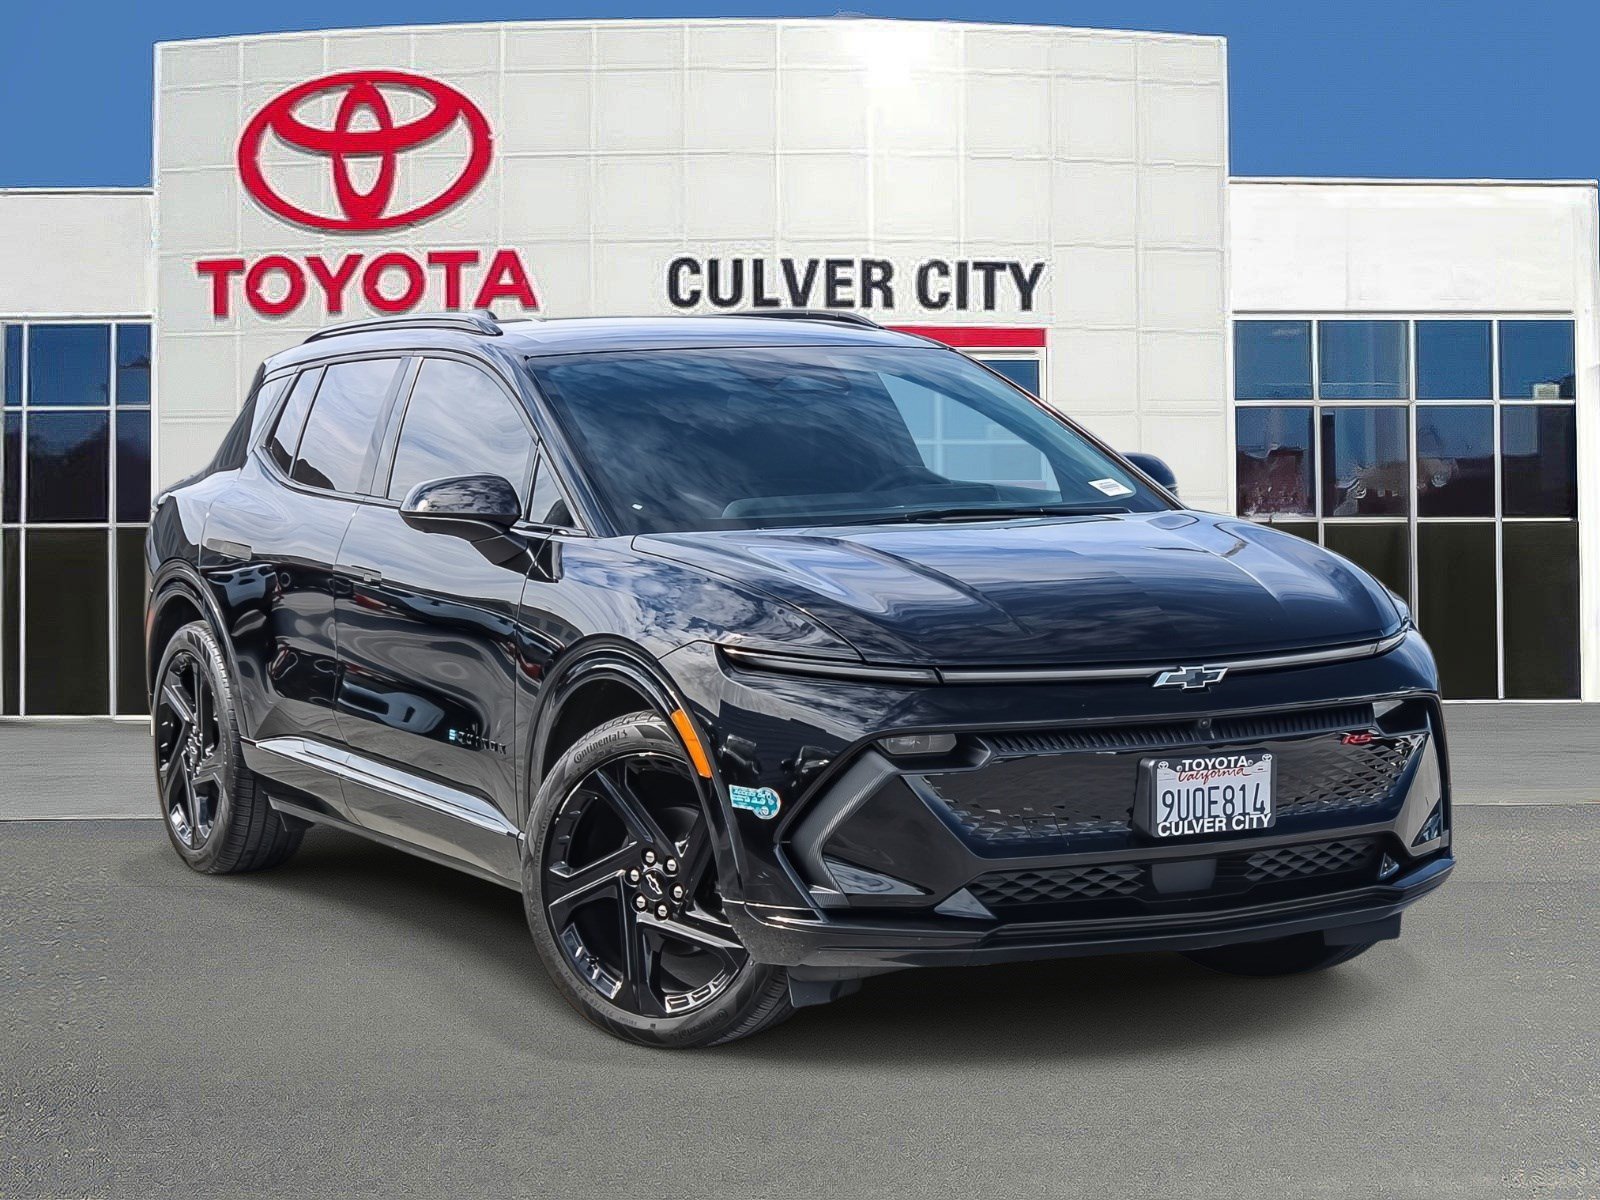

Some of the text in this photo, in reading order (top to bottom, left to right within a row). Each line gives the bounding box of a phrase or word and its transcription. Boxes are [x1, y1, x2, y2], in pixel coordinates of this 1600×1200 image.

[196, 249, 539, 317] TOYOTA
[667, 257, 1046, 311] CULVER CITY
[573, 730, 621, 764] Continental
[1341, 733, 1374, 746] RS
[1181, 755, 1248, 772] TOYOTA
[1157, 812, 1272, 837] CULVER CITY
